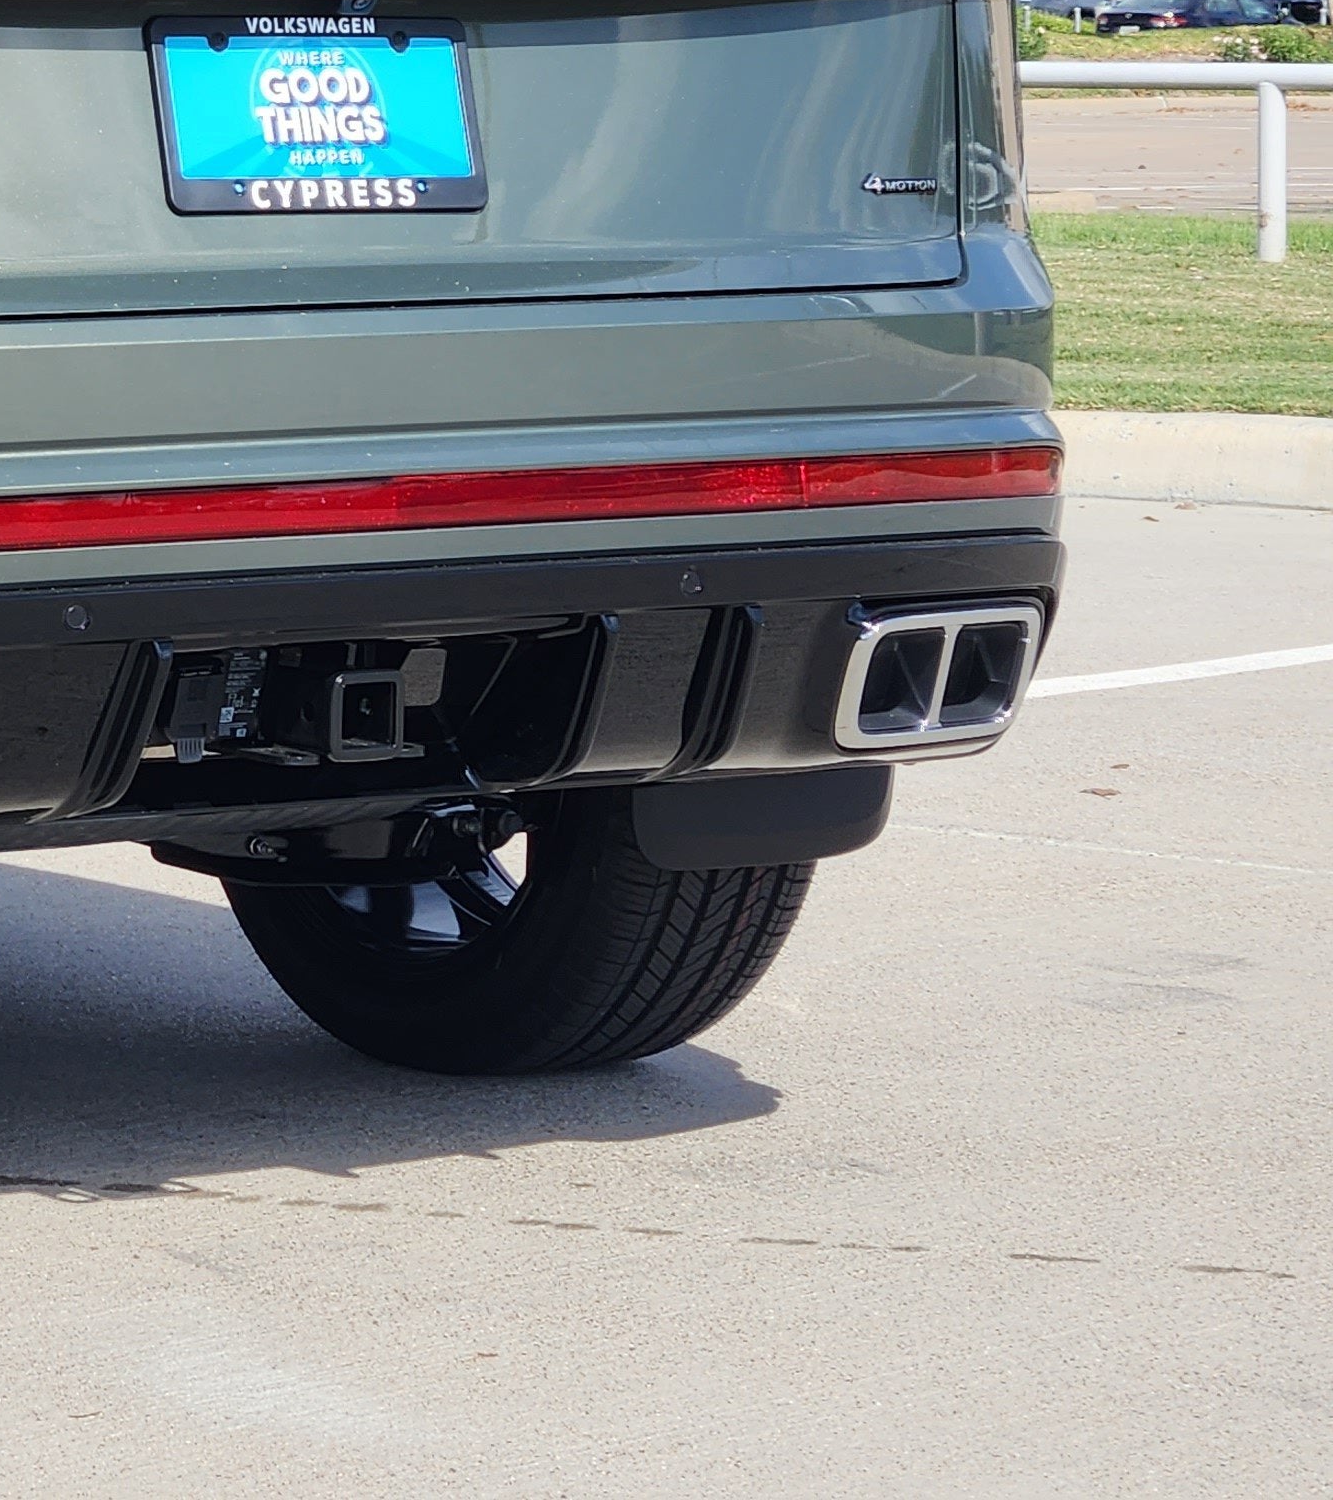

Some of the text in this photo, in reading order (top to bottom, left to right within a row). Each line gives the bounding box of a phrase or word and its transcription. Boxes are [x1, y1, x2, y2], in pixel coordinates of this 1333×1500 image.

[245, 16, 376, 35] VOLKSWAGEN
[278, 50, 346, 67] WHERE
[259, 67, 371, 105] GOOD
[255, 104, 387, 145] THINGS
[288, 148, 365, 167] HAPPEN
[251, 178, 417, 209] CYPRESS
[861, 172, 937, 195] 4MOTION
